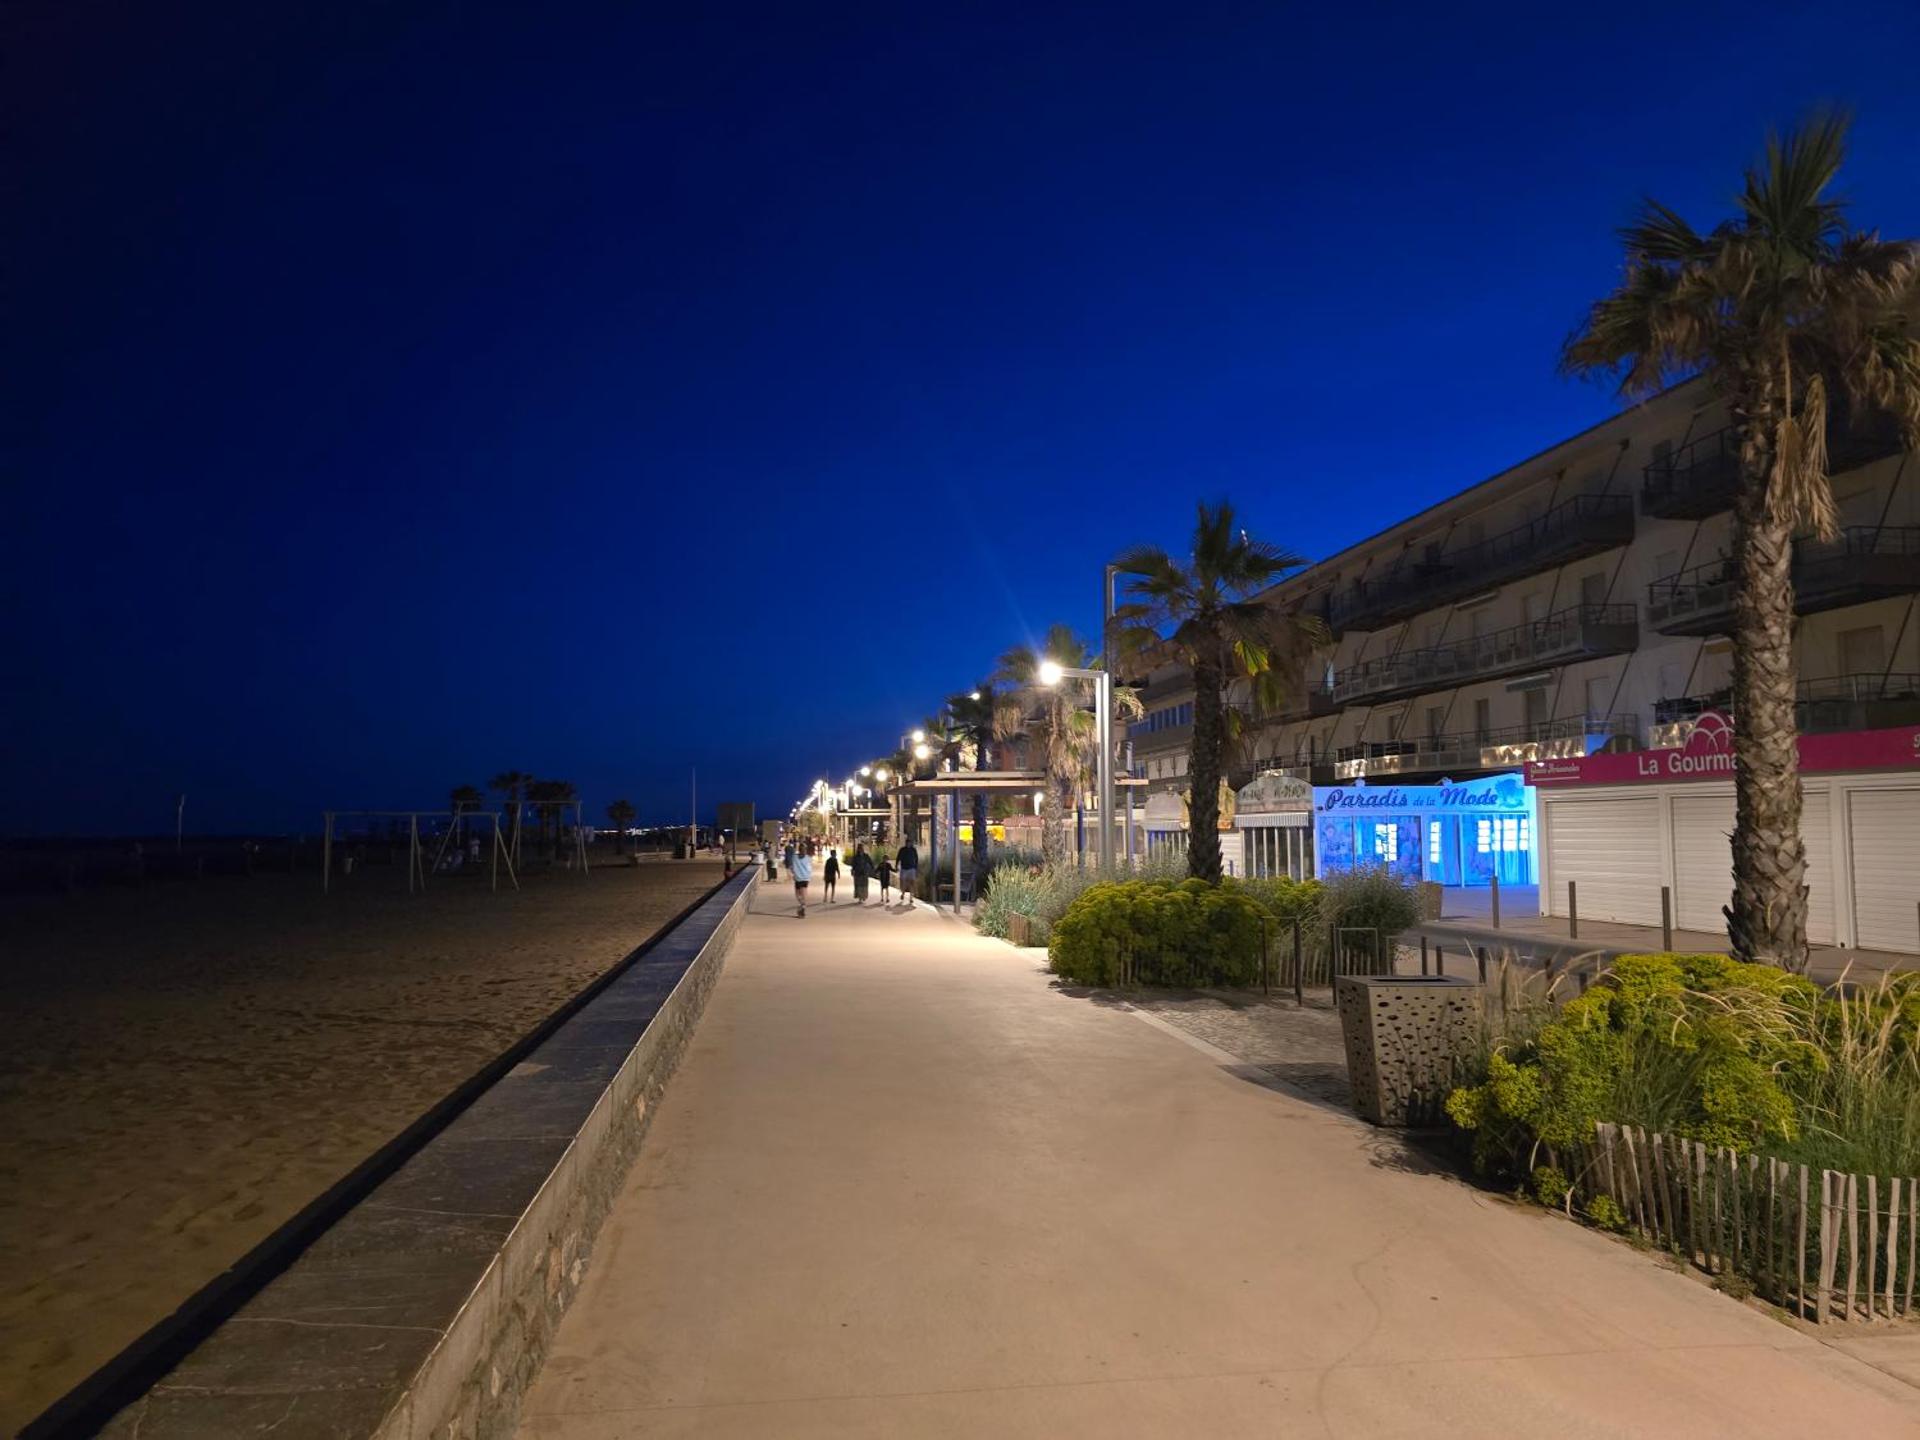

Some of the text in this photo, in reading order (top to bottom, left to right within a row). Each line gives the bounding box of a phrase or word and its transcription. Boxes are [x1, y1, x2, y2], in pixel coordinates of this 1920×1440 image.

[1638, 752, 1739, 775] La Gourma
[1325, 788, 1498, 811] Paradis de la Mode
